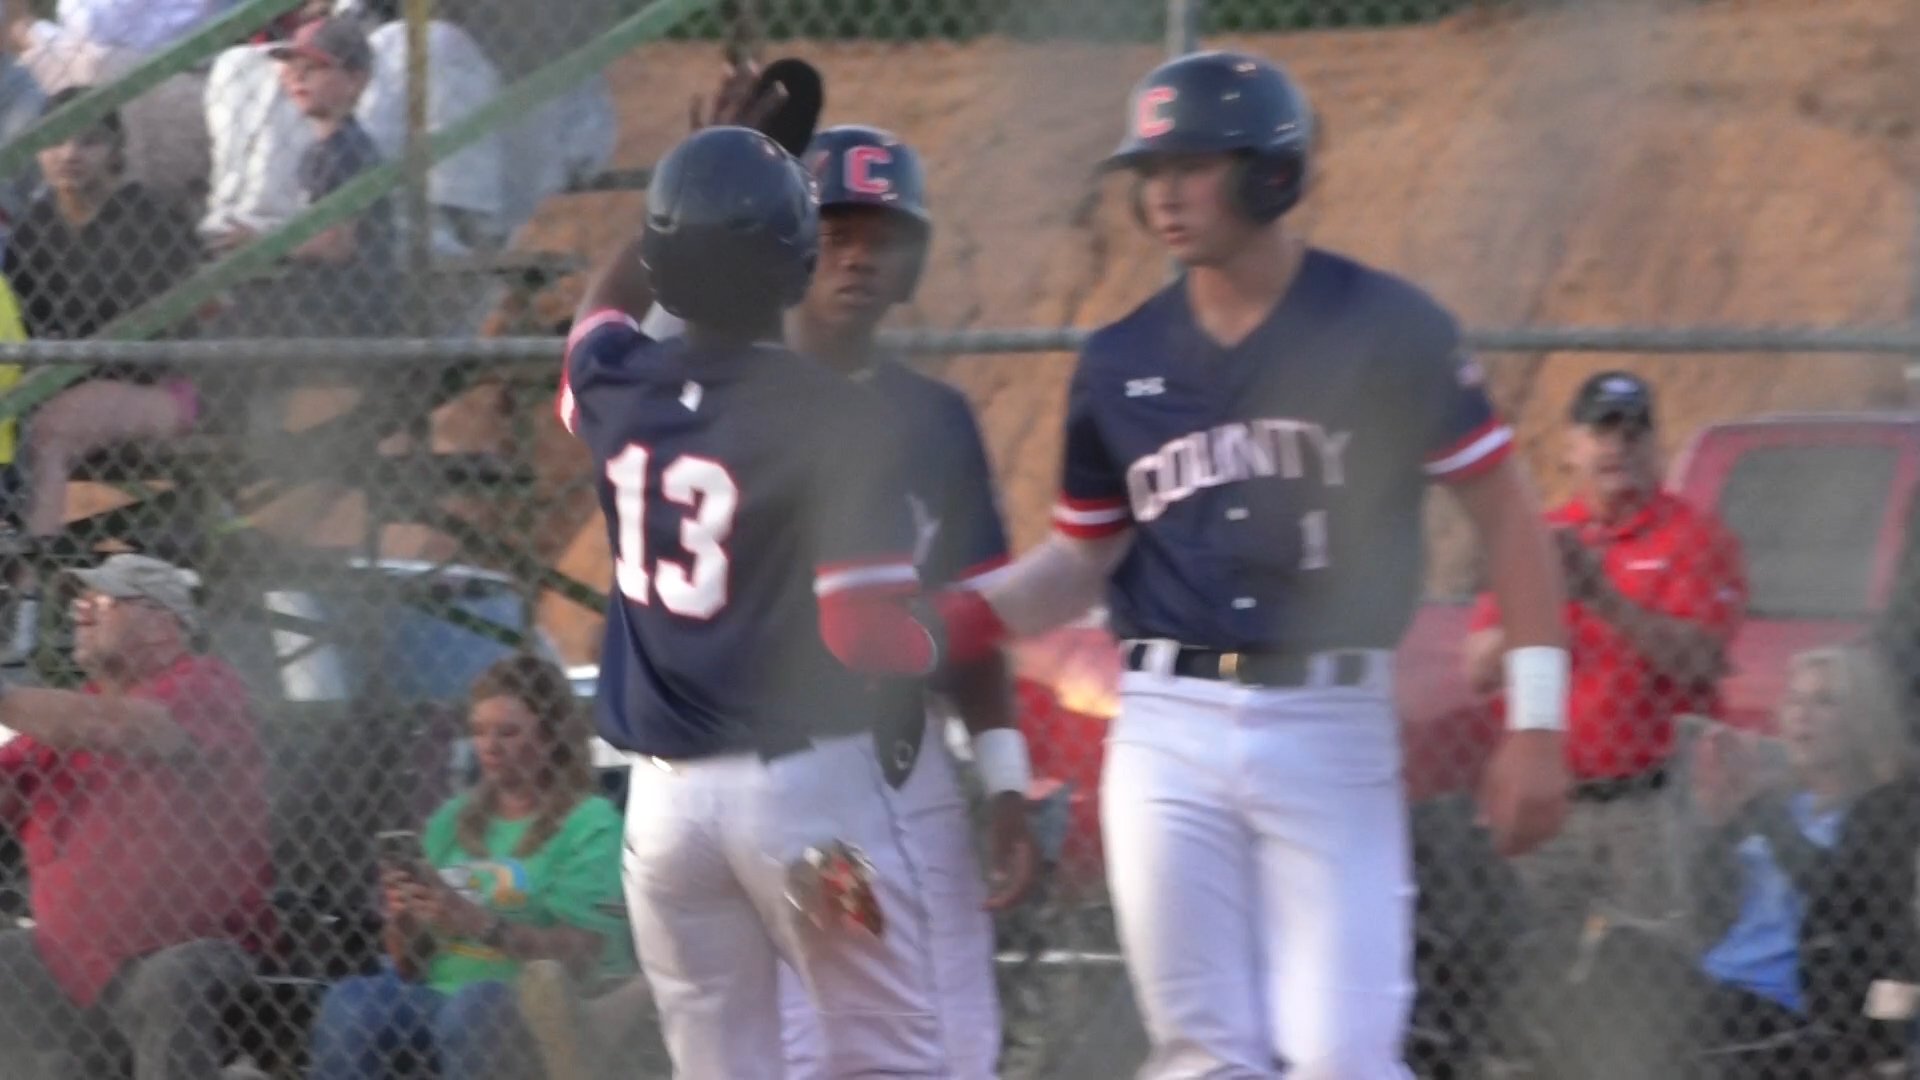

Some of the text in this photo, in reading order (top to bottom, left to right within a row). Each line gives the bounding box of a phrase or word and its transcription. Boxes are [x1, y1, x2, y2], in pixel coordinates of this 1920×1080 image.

[1138, 86, 1177, 138] C
[844, 144, 892, 194] C
[1126, 418, 1352, 521] COUNTY
[606, 443, 739, 620] 13
[1299, 509, 1330, 571] 1
